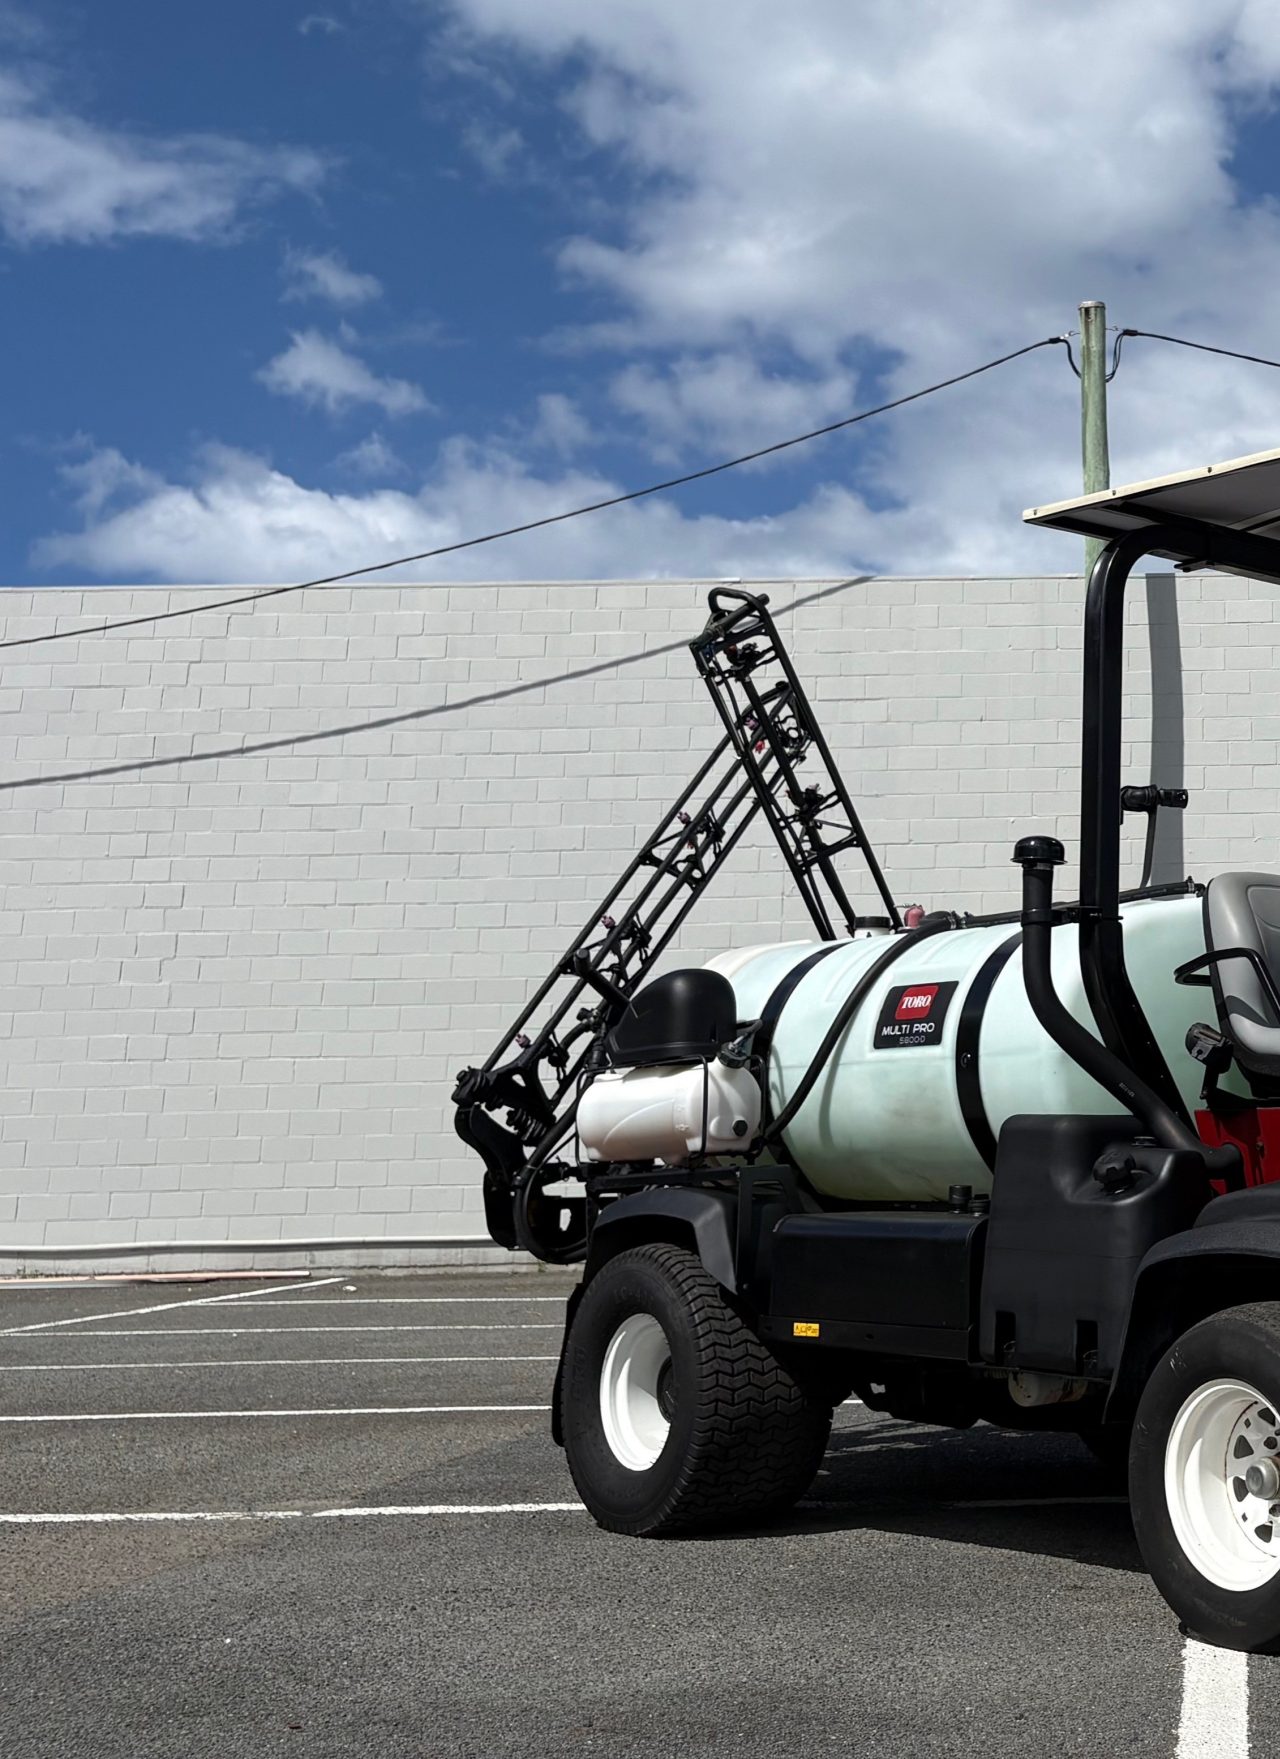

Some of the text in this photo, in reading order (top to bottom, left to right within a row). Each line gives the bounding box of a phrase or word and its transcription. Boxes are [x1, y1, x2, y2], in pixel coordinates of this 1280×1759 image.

[902, 995, 931, 1009] TORO
[881, 1022, 935, 1036] MULTI PRO
